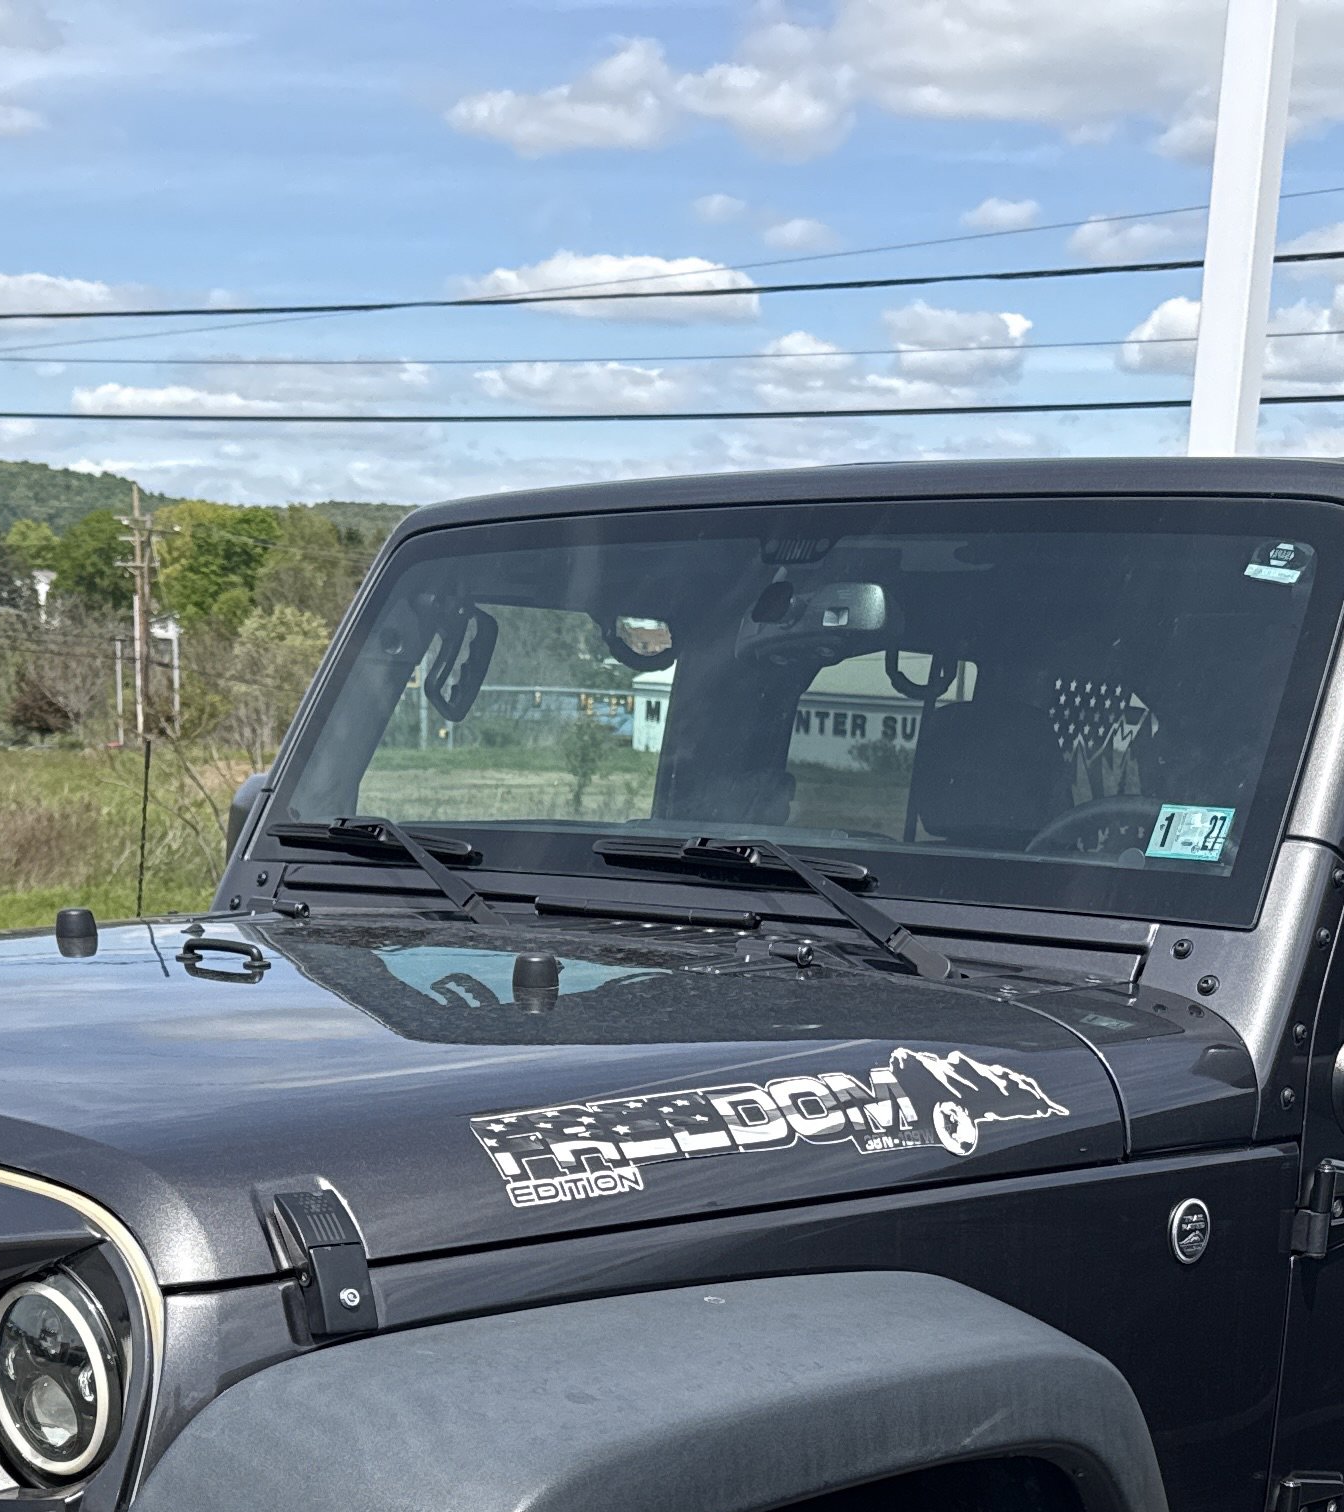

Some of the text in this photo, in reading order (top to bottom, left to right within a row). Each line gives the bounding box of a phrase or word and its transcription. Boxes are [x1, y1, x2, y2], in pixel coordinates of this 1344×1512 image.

[1159, 812, 1227, 851] 1 27
[470, 1067, 918, 1182] FREEDOM
[507, 1166, 643, 1206] EDITION
